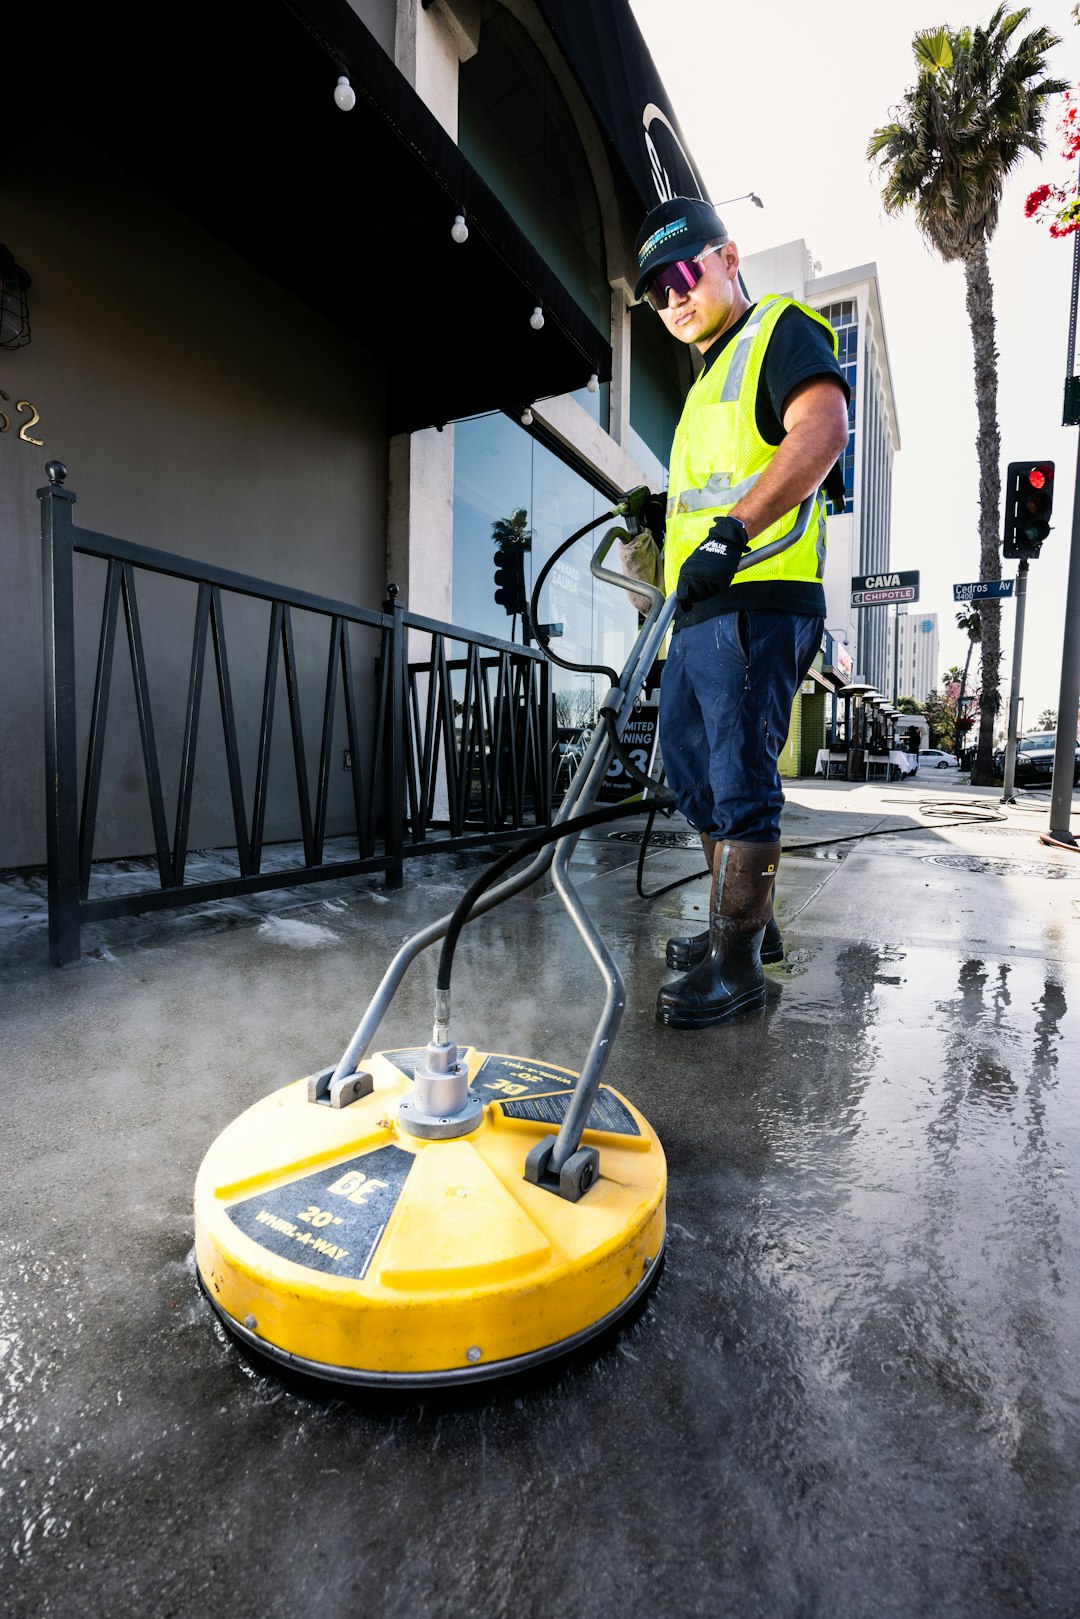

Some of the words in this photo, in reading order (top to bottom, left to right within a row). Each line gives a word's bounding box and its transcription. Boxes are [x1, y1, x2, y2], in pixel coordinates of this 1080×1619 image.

[552, 570, 578, 596] SAUNA
[865, 574, 901, 589] CAVA
[955, 584, 988, 595] Cedros
[999, 581, 1011, 591] Av
[865, 590, 912, 601] CHIPOTLE
[625, 721, 654, 732] MITED
[620, 733, 652, 744] NING
[602, 780, 612, 788] Per
[482, 1078, 529, 1096] BE
[326, 1170, 389, 1205] BE
[296, 1205, 345, 1228] 20"
[255, 1210, 350, 1261] WHIRL-A-WAY
